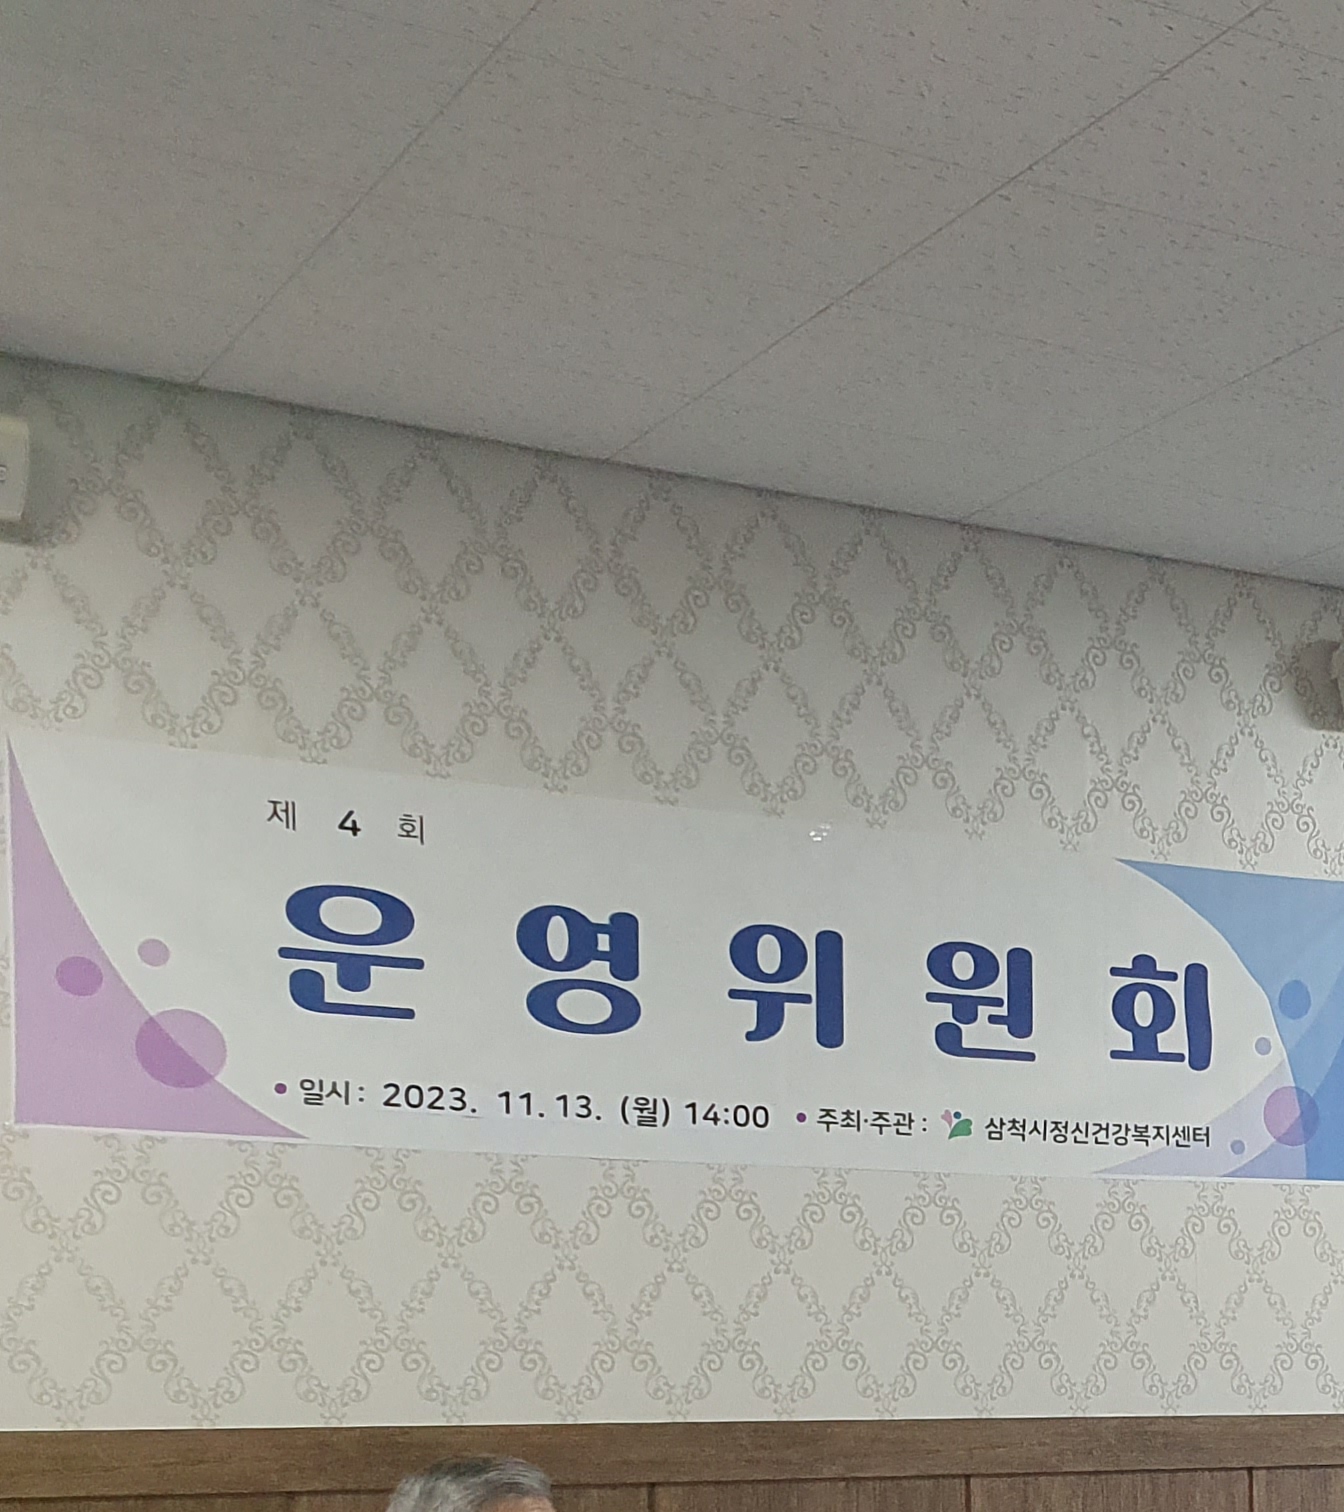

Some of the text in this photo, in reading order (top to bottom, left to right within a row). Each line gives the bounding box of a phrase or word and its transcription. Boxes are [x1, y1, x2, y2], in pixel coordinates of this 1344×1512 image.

[382, 1082, 478, 1114] 2023.
[620, 1095, 671, 1128] (월)
[684, 1101, 770, 1129] 14:00
[984, 1117, 1211, 1149] 삼척시정신건강복지센터
